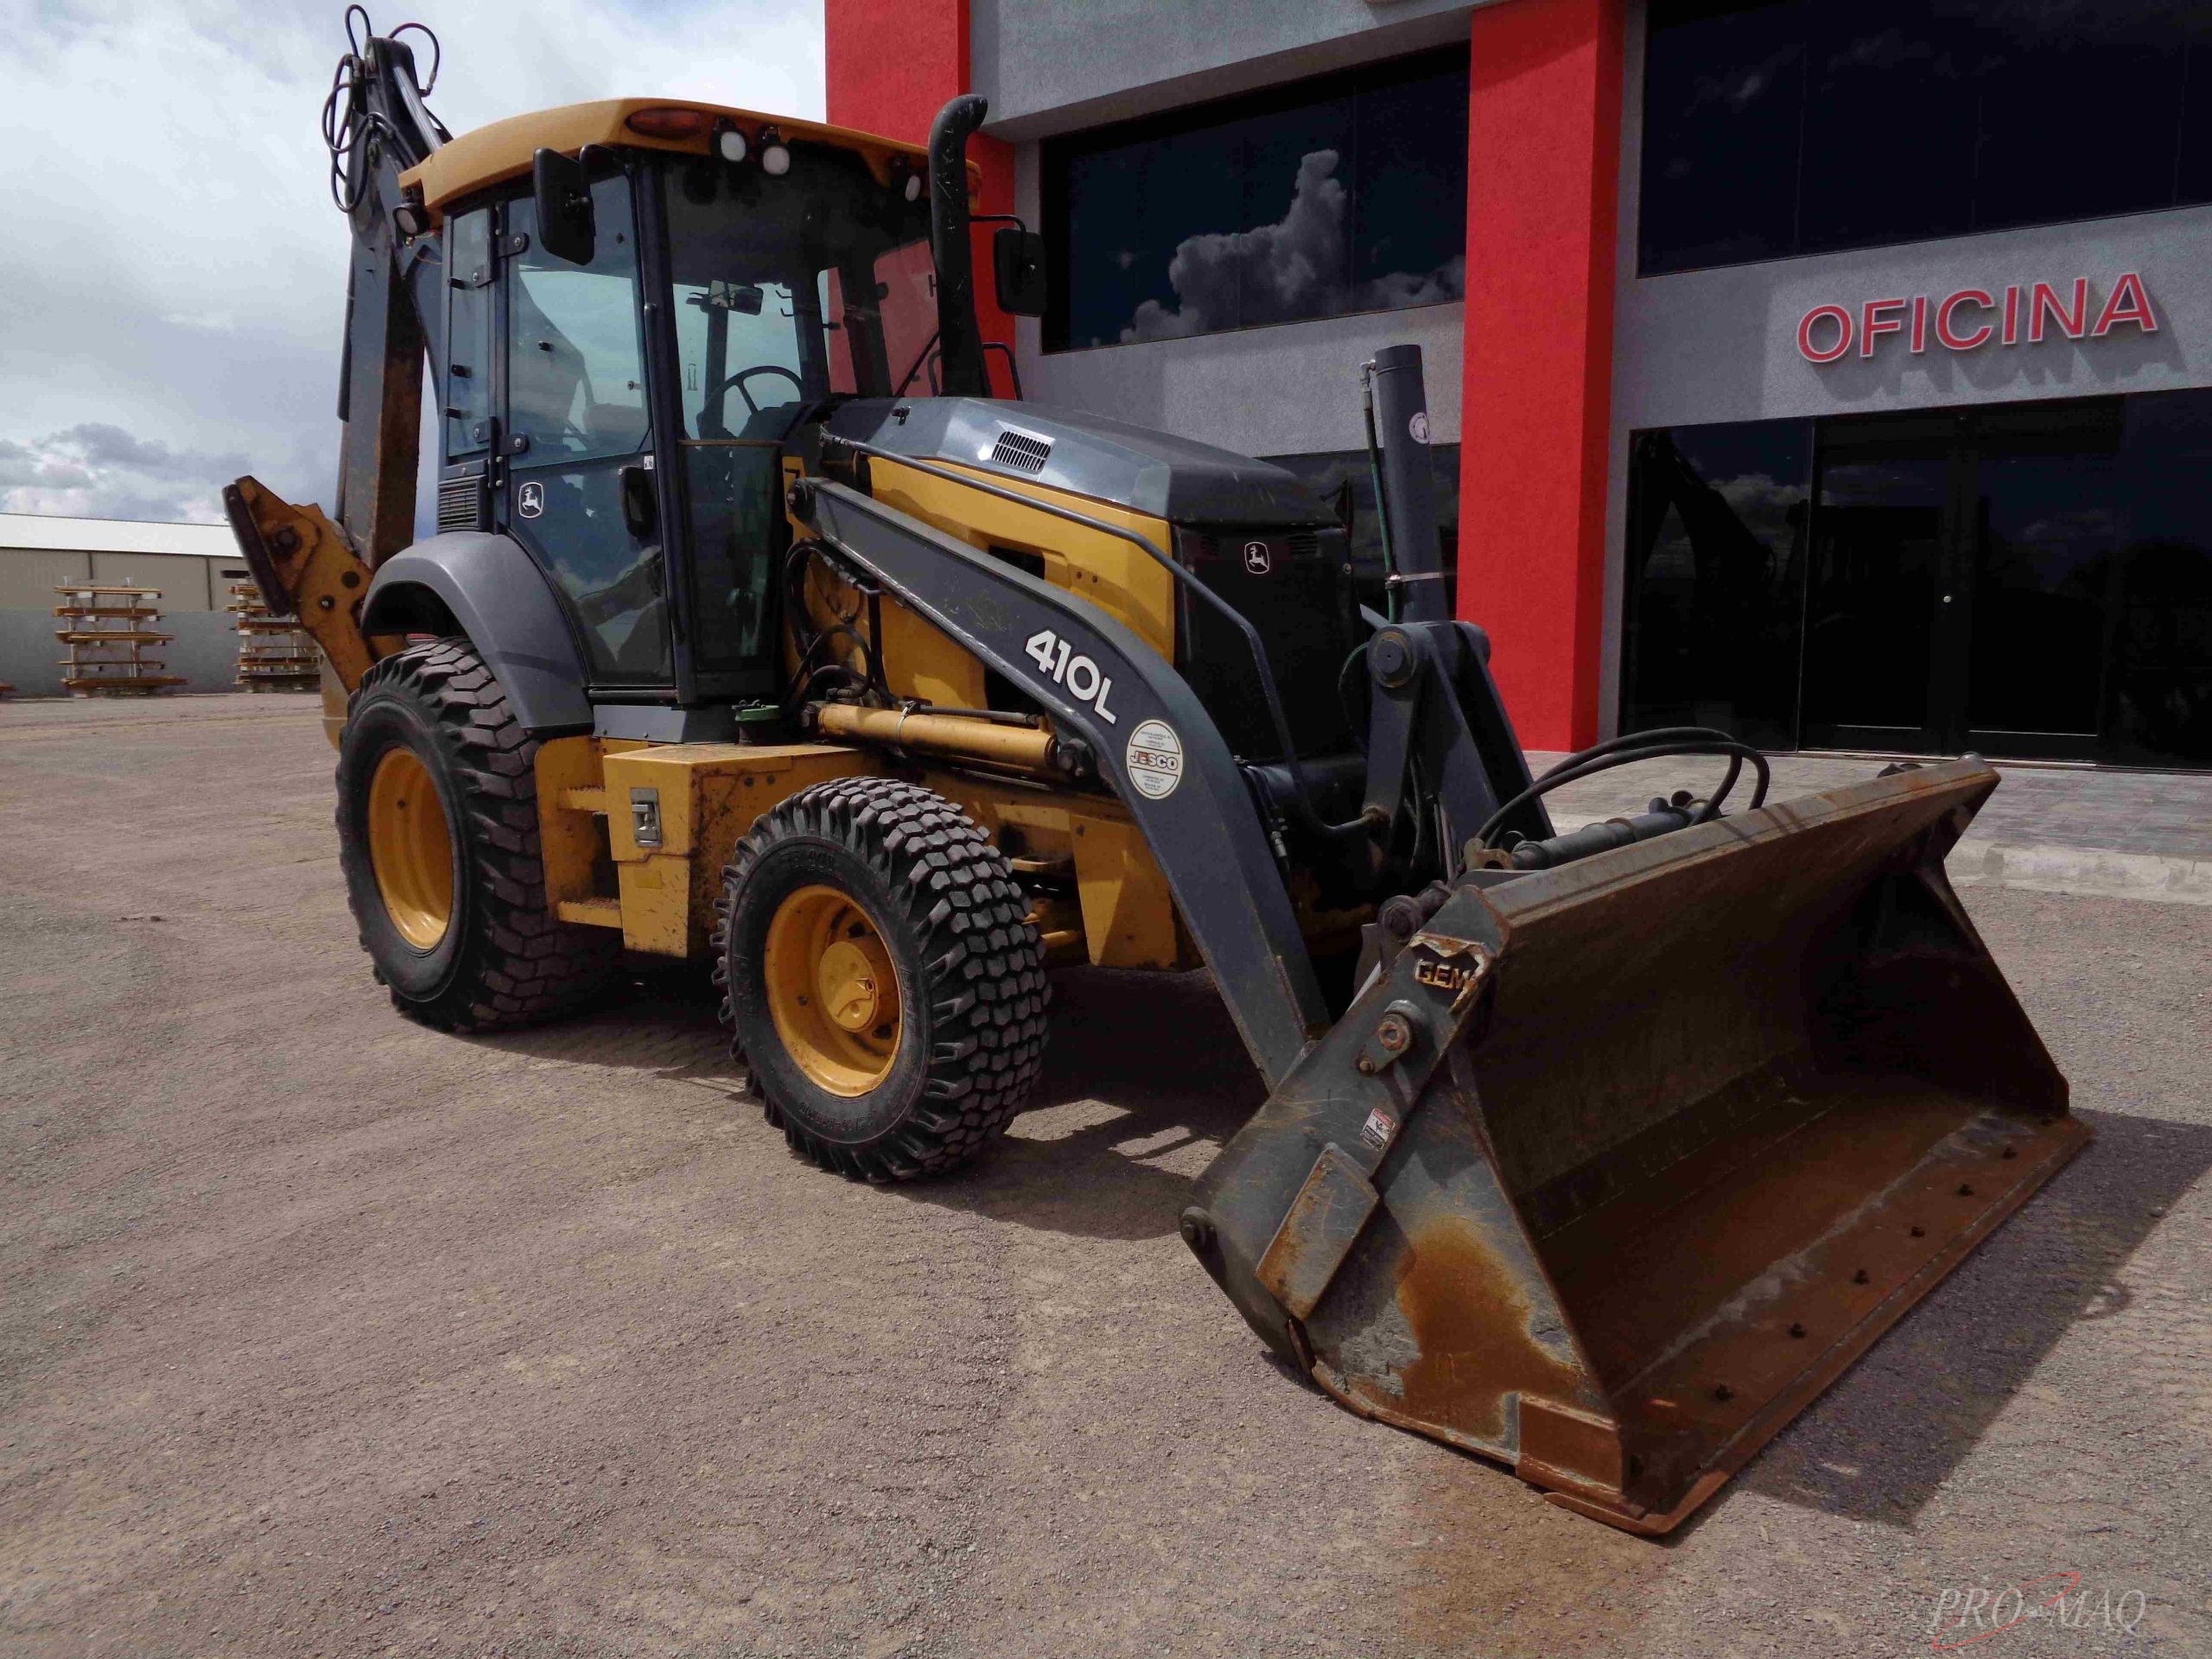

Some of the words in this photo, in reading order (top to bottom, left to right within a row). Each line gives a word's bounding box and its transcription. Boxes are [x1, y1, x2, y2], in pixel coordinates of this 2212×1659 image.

[1796, 272, 2158, 363] OFICINA
[1025, 630, 1116, 725] 410L
[1129, 750, 1179, 772] JESCO
[1414, 957, 1471, 990] GEM
